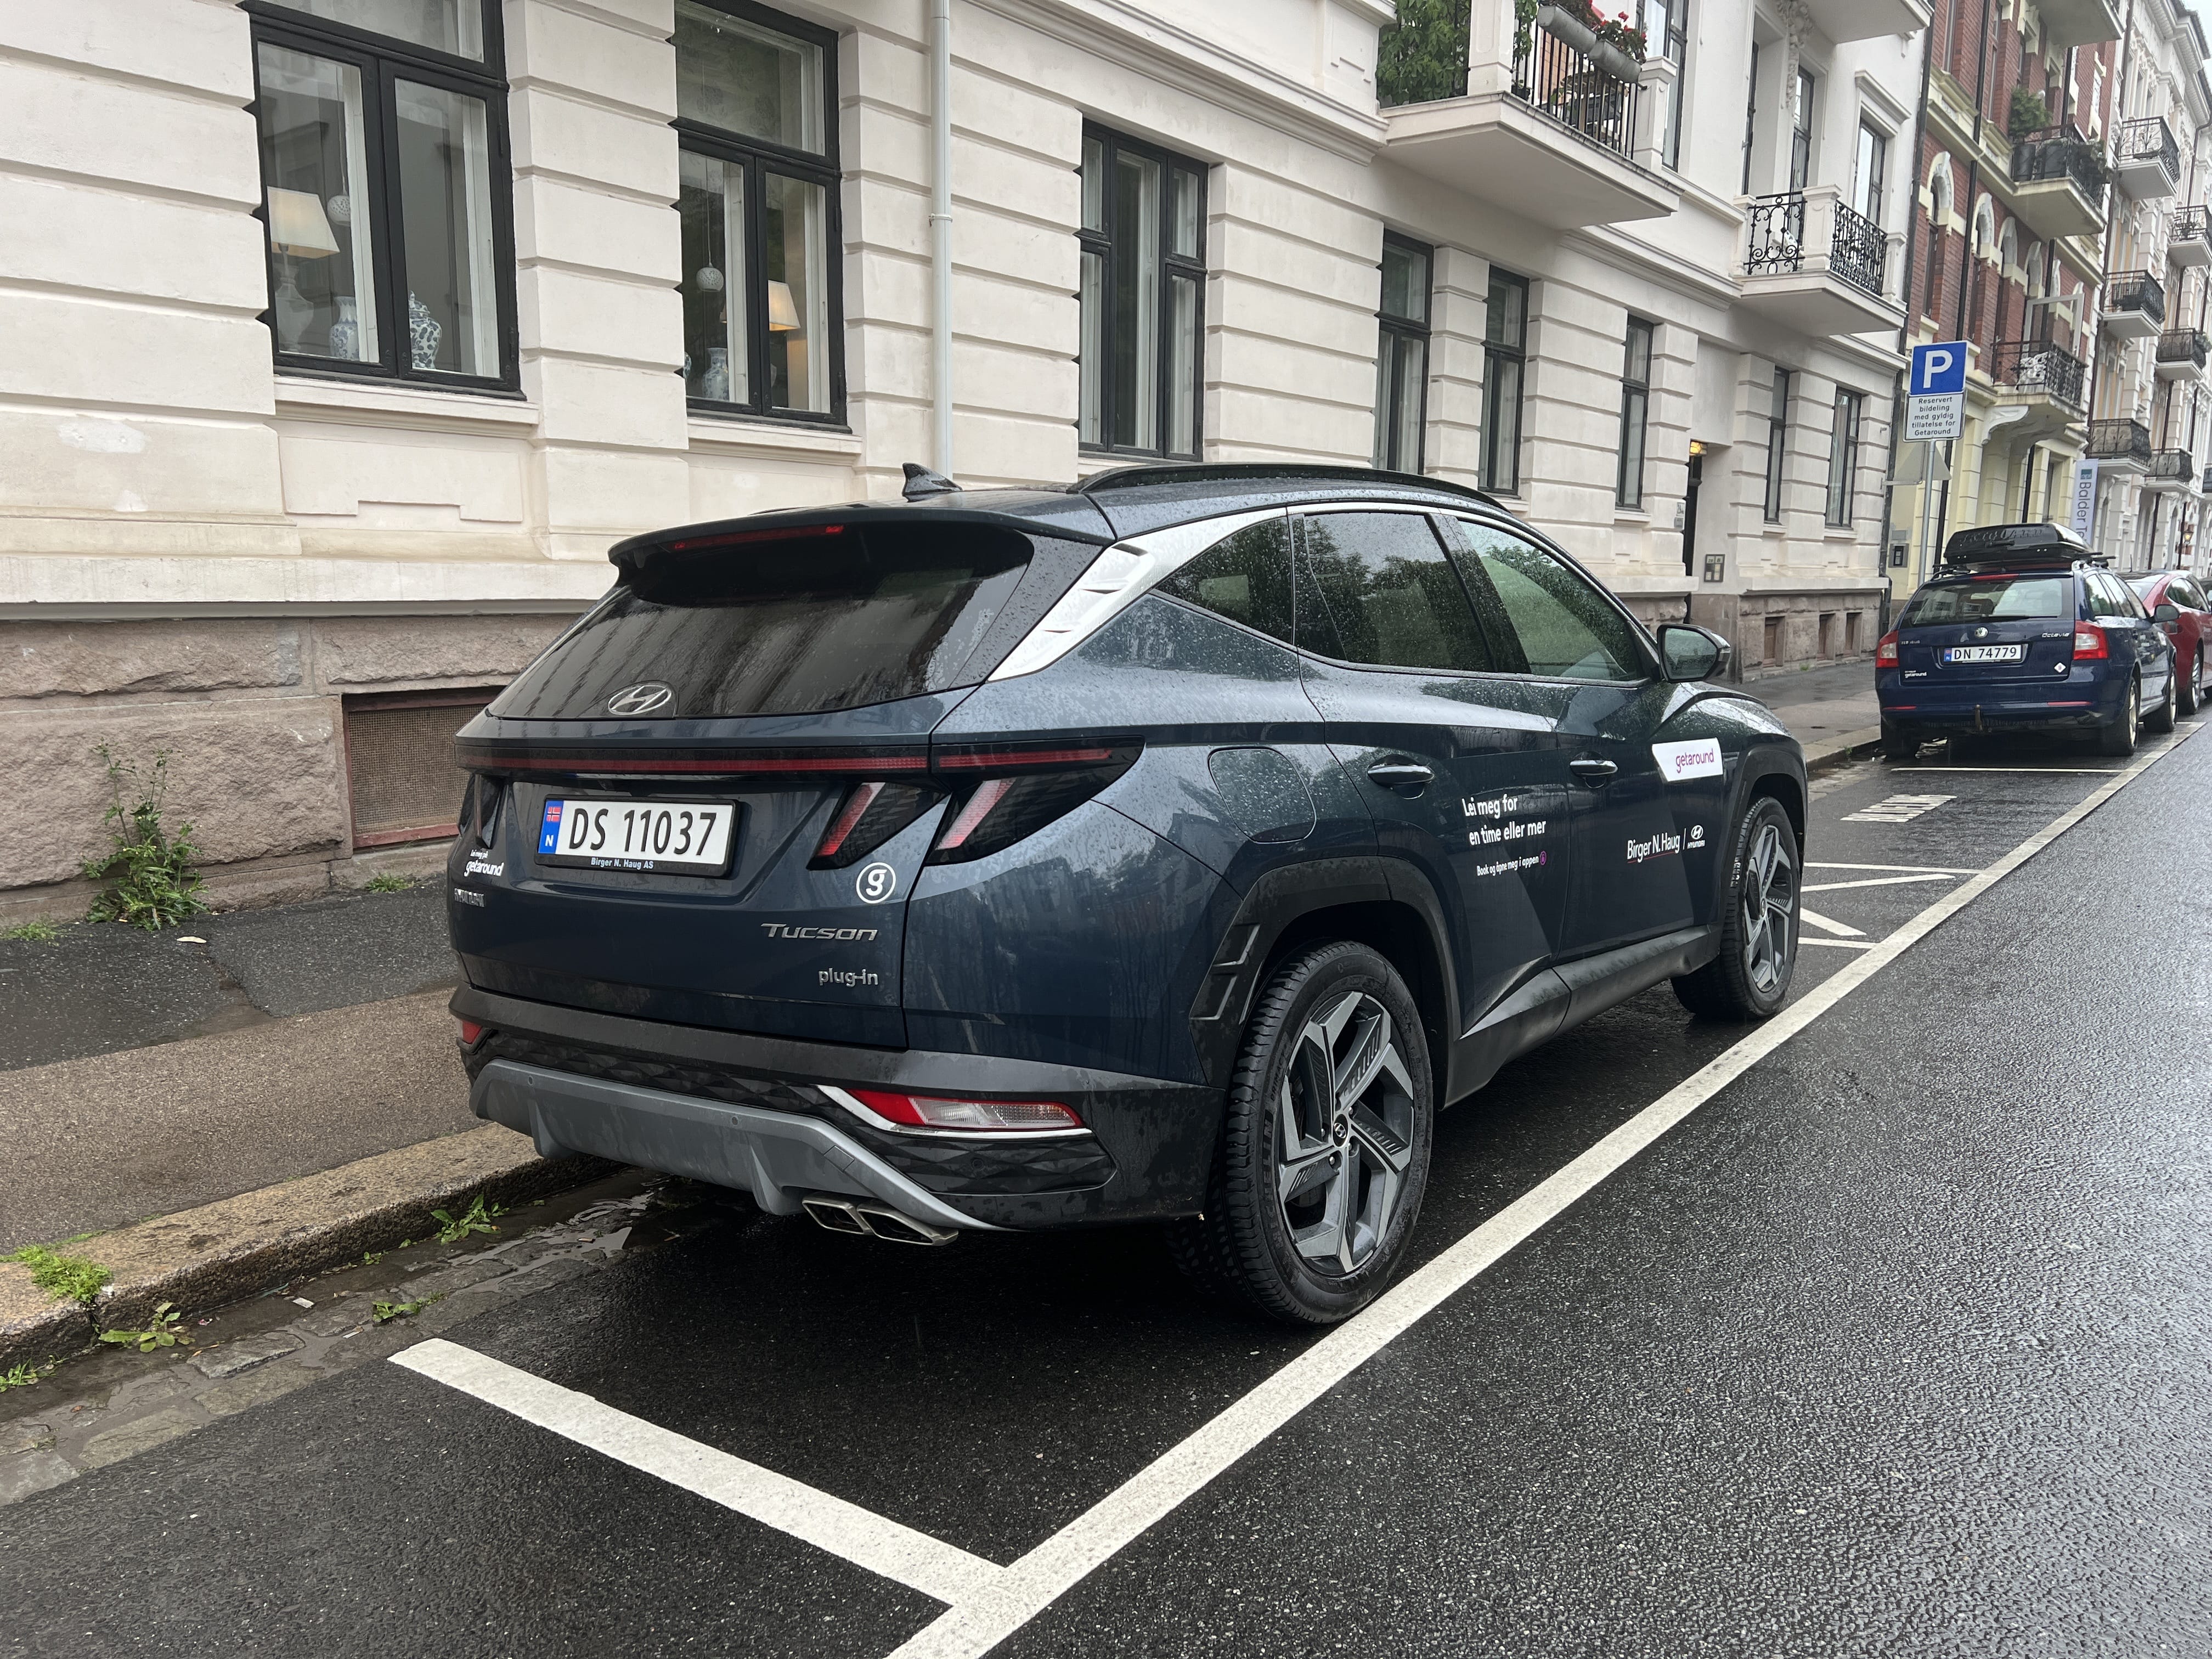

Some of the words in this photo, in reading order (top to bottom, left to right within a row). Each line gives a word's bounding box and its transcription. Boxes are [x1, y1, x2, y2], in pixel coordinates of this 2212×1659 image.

[1923, 350, 1953, 388] P
[1932, 413, 1954, 421] gyldig
[2076, 482, 2091, 522] Balder
[1954, 650, 1971, 659] DN
[1979, 647, 2017, 659] 74779
[1676, 748, 1714, 774] getaround
[1462, 797, 1477, 816] Lei
[1477, 798, 1500, 819] meg
[1502, 793, 1518, 812] for
[545, 834, 554, 847] N
[569, 808, 608, 850] DS
[624, 809, 717, 856] 11037
[1469, 831, 1481, 846] en
[1481, 824, 1502, 844] time
[1503, 821, 1525, 840] eller
[1527, 821, 1547, 836] mer
[1627, 839, 1652, 863] Birger
[1652, 834, 1661, 854] N.
[1661, 832, 1680, 854] Haug
[1687, 840, 1705, 849] HYUNDAI
[464, 860, 504, 877] getaround
[591, 857, 612, 867] Birger
[614, 859, 621, 867] N.
[623, 859, 641, 870] Haug
[643, 861, 653, 869] AS
[1476, 864, 1489, 876] Book
[1489, 865, 1496, 876] og
[1496, 861, 1507, 874] åpne
[1508, 860, 1518, 871] meg
[1519, 856, 1522, 867] i
[1522, 856, 1539, 868] appen
[819, 968, 878, 987] plug-in
